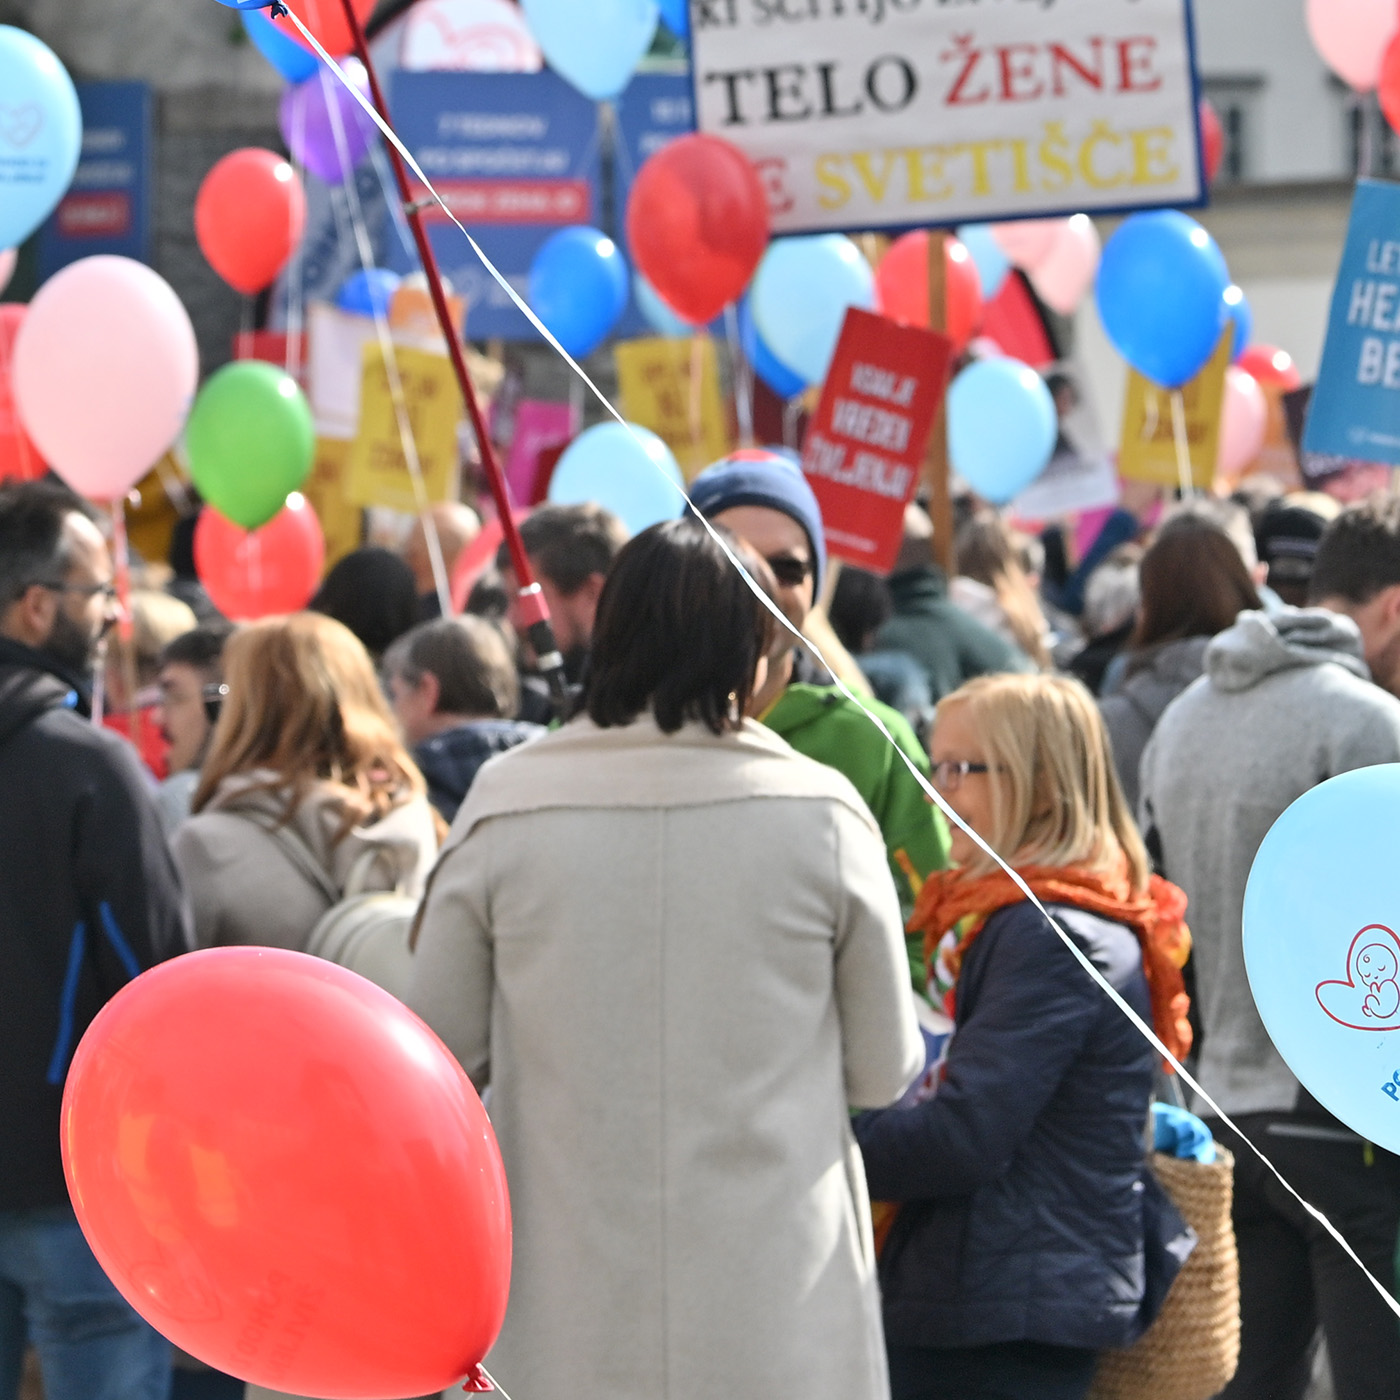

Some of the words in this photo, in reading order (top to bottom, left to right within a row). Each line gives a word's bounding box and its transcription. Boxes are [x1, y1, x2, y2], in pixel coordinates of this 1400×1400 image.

[705, 52, 920, 127] TELO
[940, 32, 1162, 108] ŽENE
[815, 119, 1182, 212] SVETIŠČE
